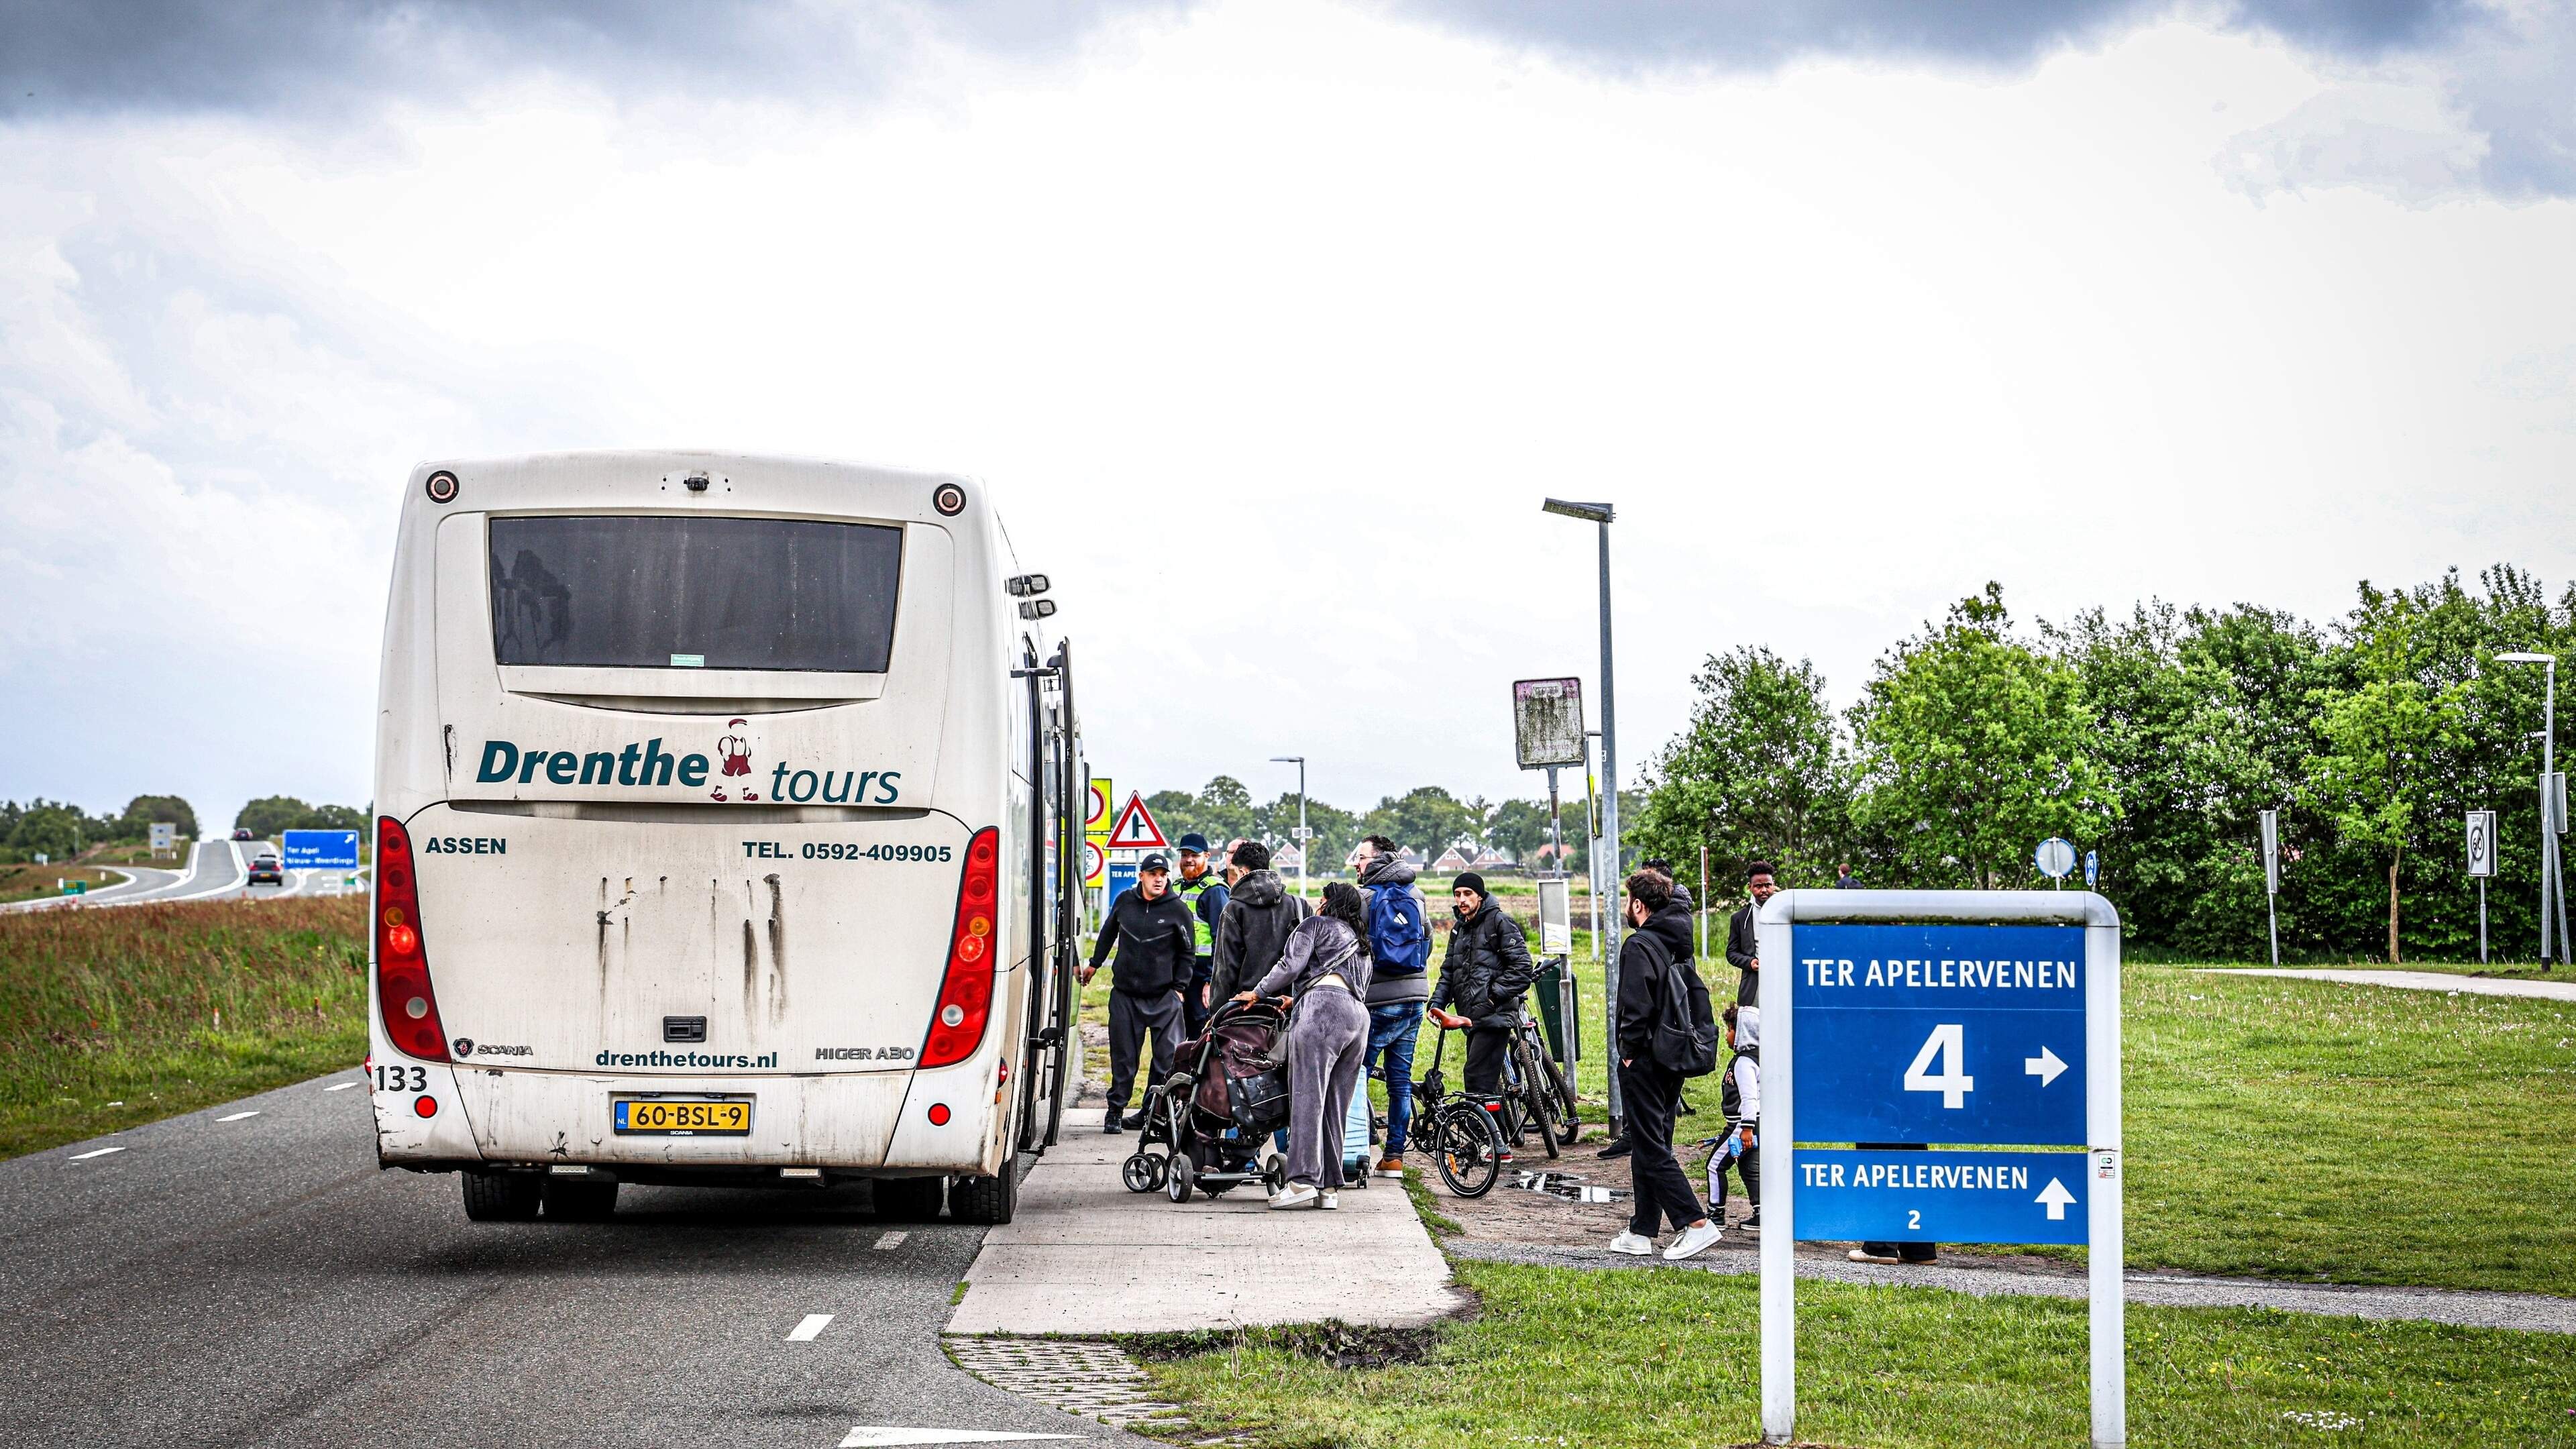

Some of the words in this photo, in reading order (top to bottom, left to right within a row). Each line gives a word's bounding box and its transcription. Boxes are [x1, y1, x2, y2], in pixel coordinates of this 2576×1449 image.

[476, 738, 709, 787] Drenthe
[771, 761, 901, 804] tours
[425, 837, 506, 855] ASSEN
[743, 841, 794, 859] TEL.
[802, 843, 951, 863] 0592-409905
[2473, 837, 2482, 851] 60
[1802, 959, 1855, 986] TER
[1865, 960, 2076, 988] APELERVENEN
[477, 1044, 533, 1056] SCANIA
[596, 1050, 777, 1068] drenthetours.nl
[815, 1048, 872, 1060] HIGER
[875, 1047, 915, 1060] A30
[1904, 1024, 1974, 1109] 4
[375, 1065, 427, 1092] 133
[637, 1106, 742, 1126] 60-BSL-9
[1801, 1164, 1845, 1187] TER
[1853, 1165, 2028, 1189] APELERVENEN
[1908, 1210, 1921, 1230] 2
